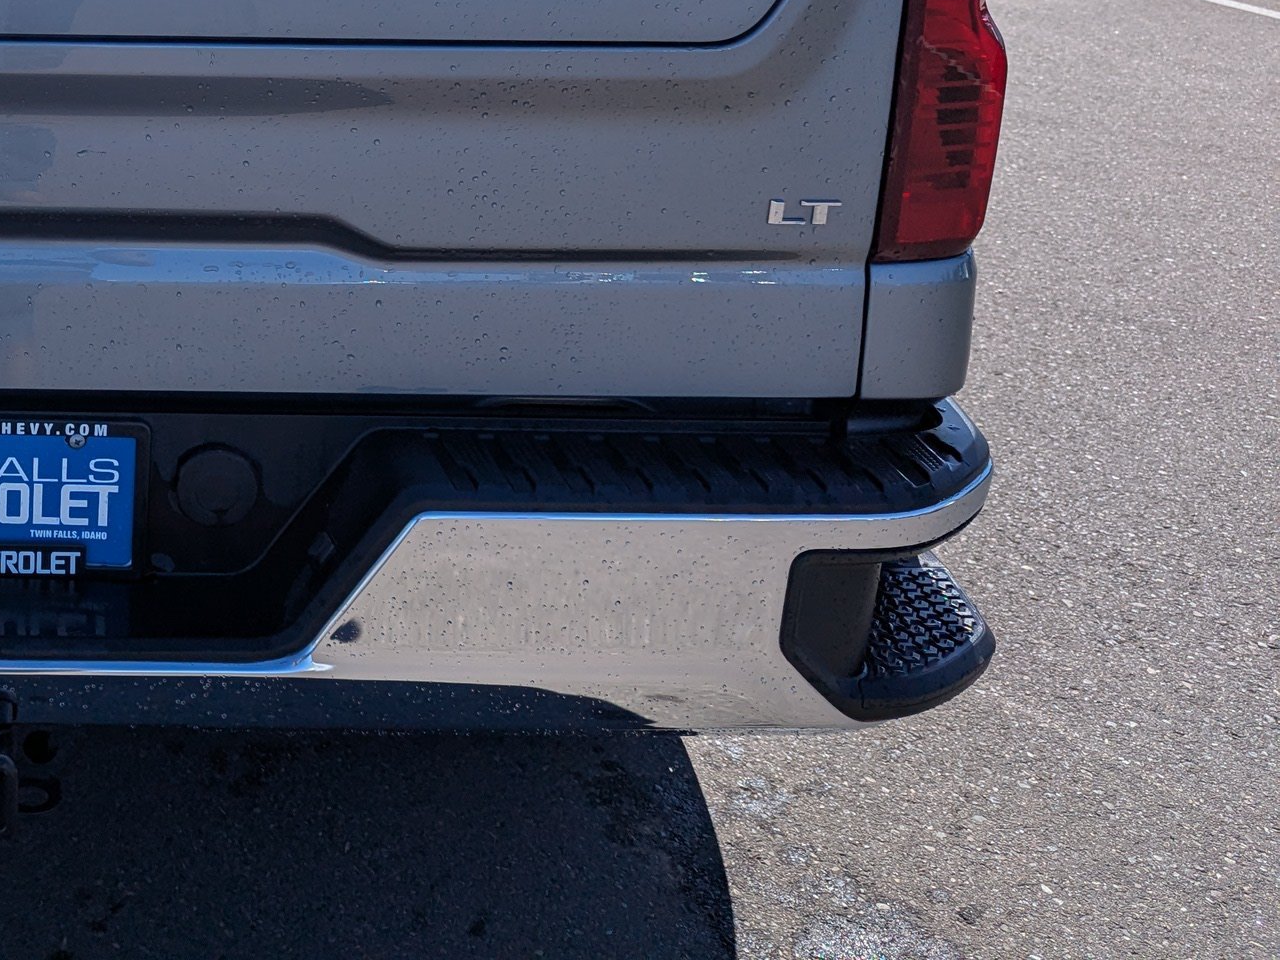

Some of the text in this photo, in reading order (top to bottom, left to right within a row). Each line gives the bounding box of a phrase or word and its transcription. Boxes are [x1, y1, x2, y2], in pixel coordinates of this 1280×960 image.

[767, 199, 843, 225] LT
[30, 529, 108, 540] TWIN FALLS, IDAHO
